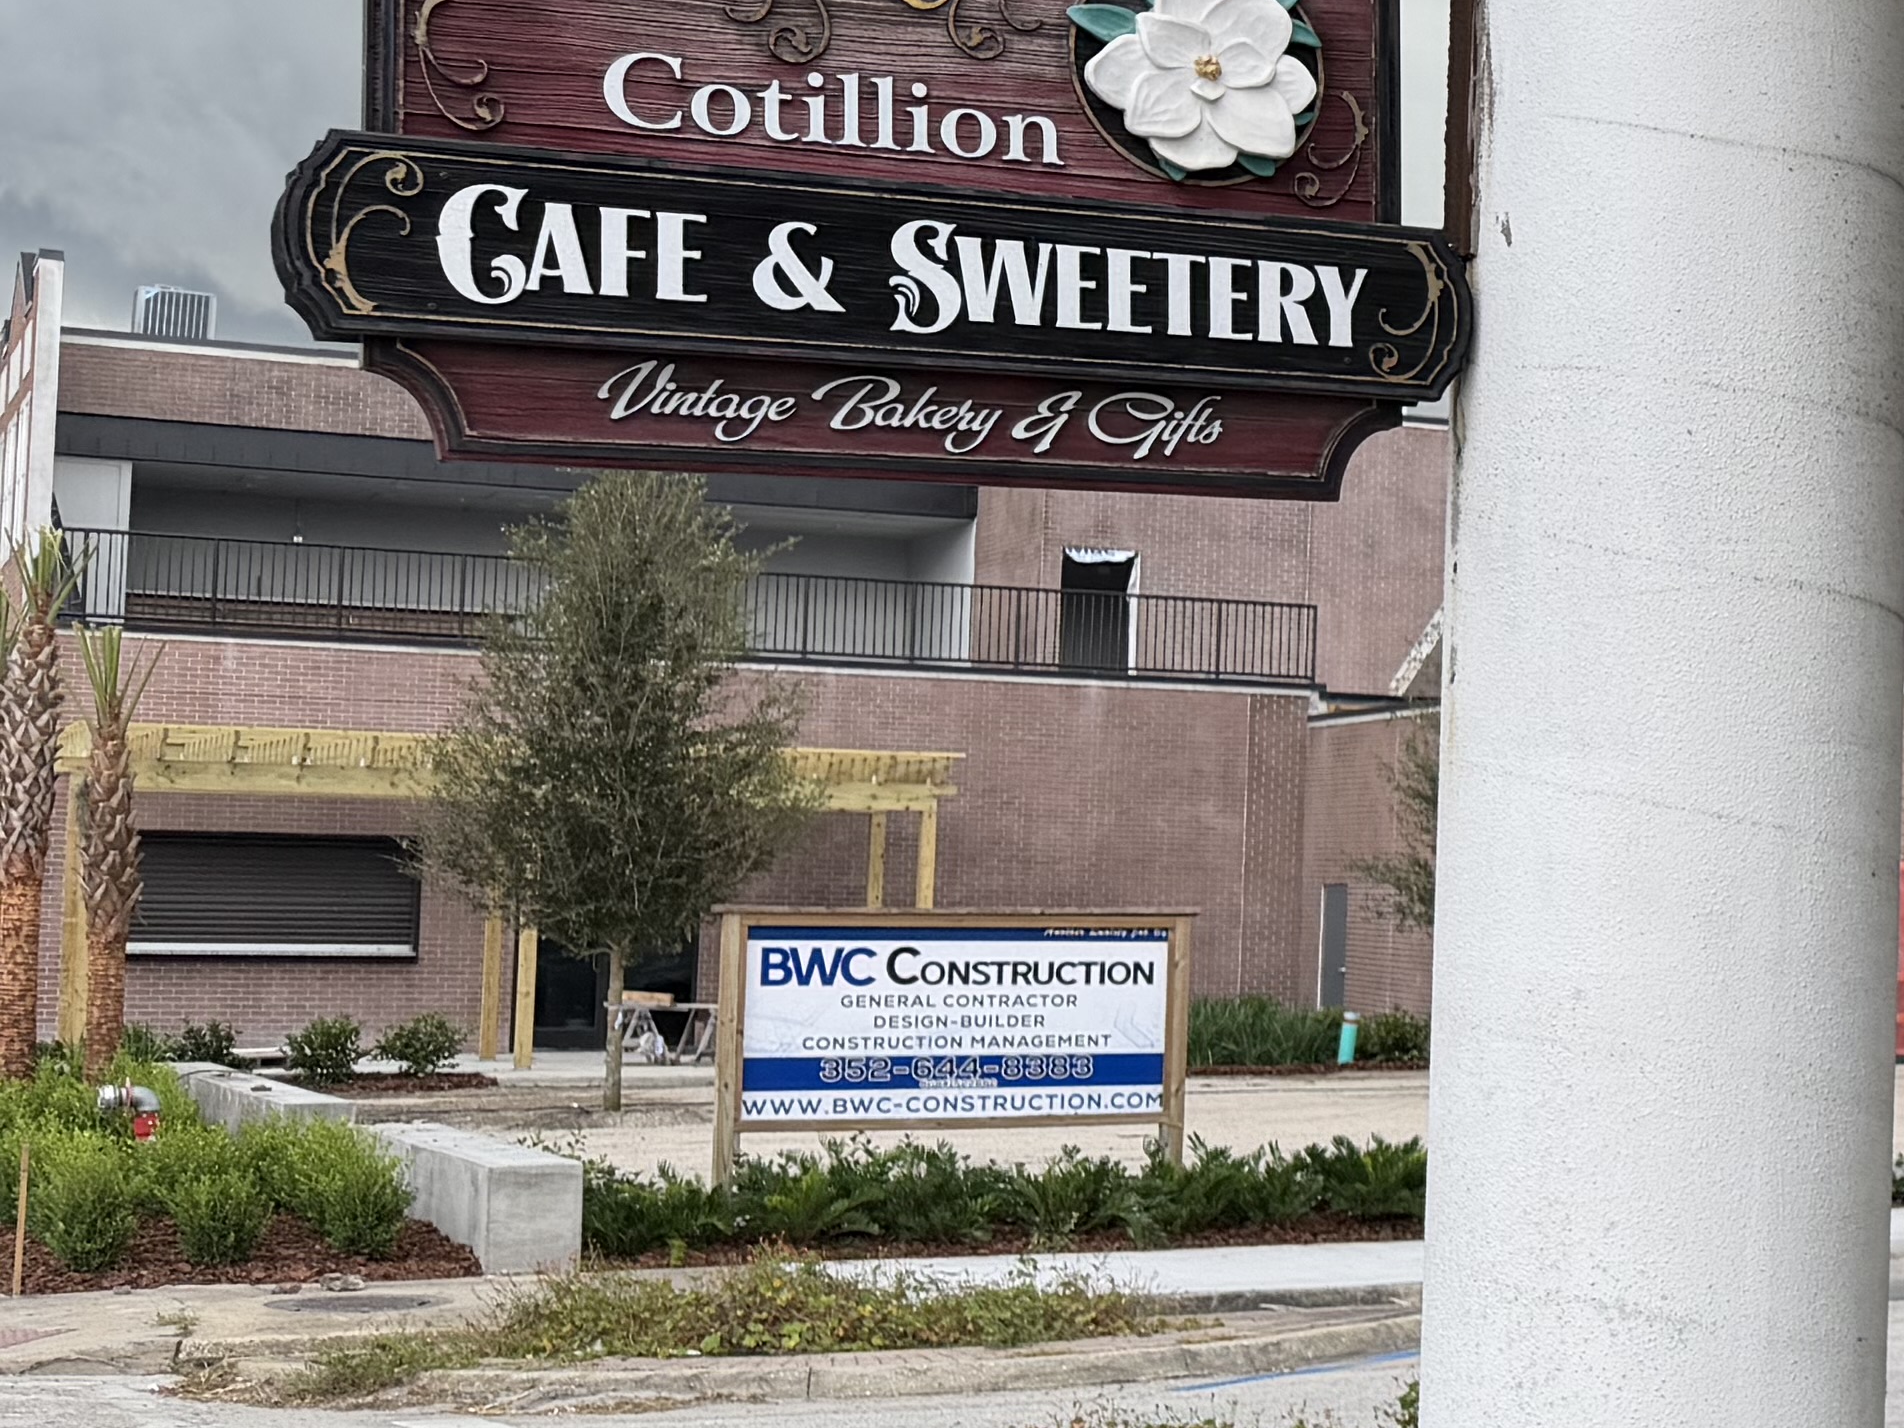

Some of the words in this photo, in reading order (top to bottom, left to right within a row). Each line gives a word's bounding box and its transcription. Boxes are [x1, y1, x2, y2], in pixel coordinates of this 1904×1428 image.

[602, 52, 1065, 169] Cotillion
[435, 182, 707, 305] CAFE
[753, 221, 846, 314] &
[889, 218, 1370, 350] SWEETERY
[598, 361, 796, 445] Vintage
[812, 374, 1003, 453] Bakery
[1009, 390, 1083, 459] &
[1087, 392, 1225, 461] Gifts
[759, 946, 878, 987] BWC
[886, 946, 1155, 987] CONSTRUCTION
[840, 993, 937, 1009] GENERAL
[943, 993, 1079, 1008] CONTRACTOR
[873, 1014, 1046, 1029] DESIGN-BUILDER
[801, 1035, 963, 1051] CONSTRUCTION
[970, 1033, 1112, 1049] MANAGEMENT
[819, 1055, 1095, 1083] 352-644-8383
[742, 1091, 1164, 1117] WWW.BWC-CONSTRUCTION.COM
